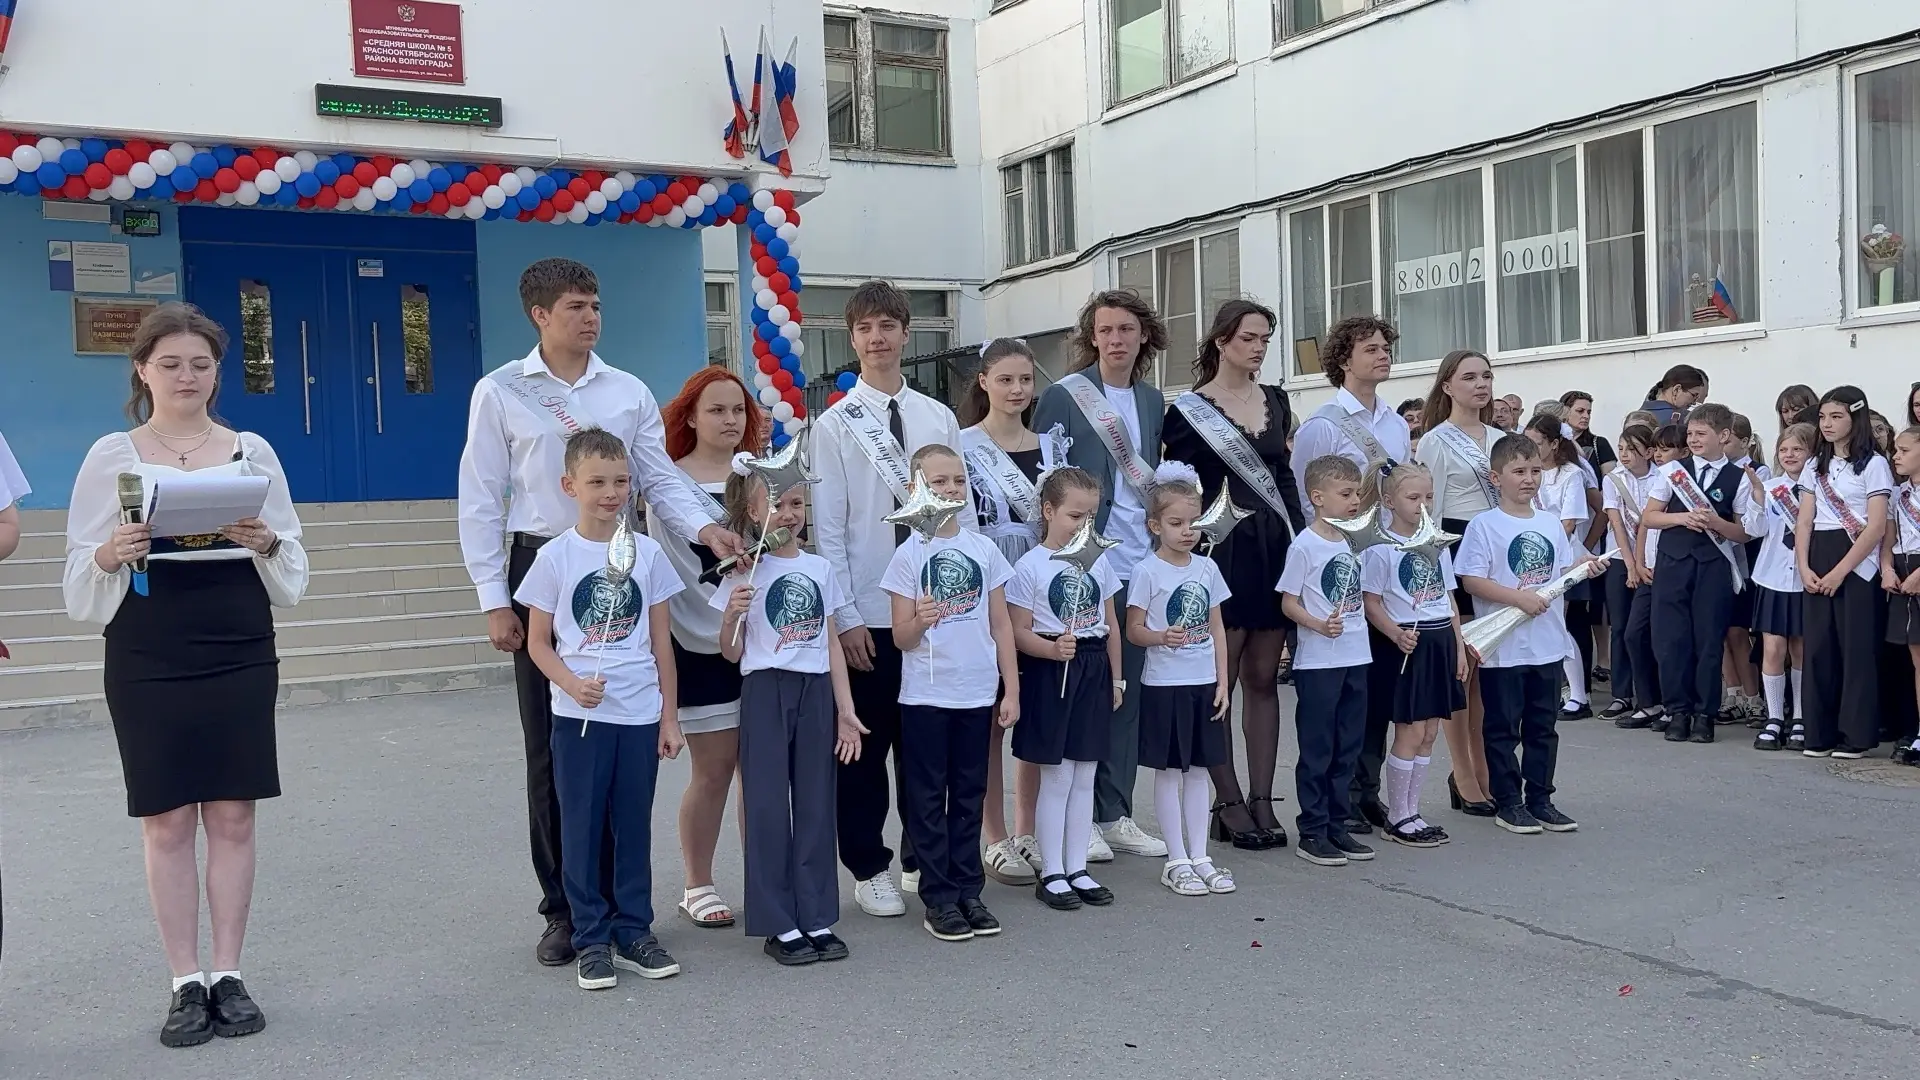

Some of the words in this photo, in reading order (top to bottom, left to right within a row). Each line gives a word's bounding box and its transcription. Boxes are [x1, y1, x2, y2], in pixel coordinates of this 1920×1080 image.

[364, 39, 406, 49] «СРЕДНЯЯ
[407, 42, 436, 51] ШКОЛА
[362, 46, 454, 60] КРАСНООКТЯБРЬСКОГО
[364, 54, 397, 64] РАЙОНА
[398, 58, 453, 68] ВОЛГОГРАДА»
[125, 217, 158, 229] ВХОД
[93, 321, 141, 329] ВРЕМЕННОГО
[92, 331, 135, 339] РАЗМЕЩЕН
